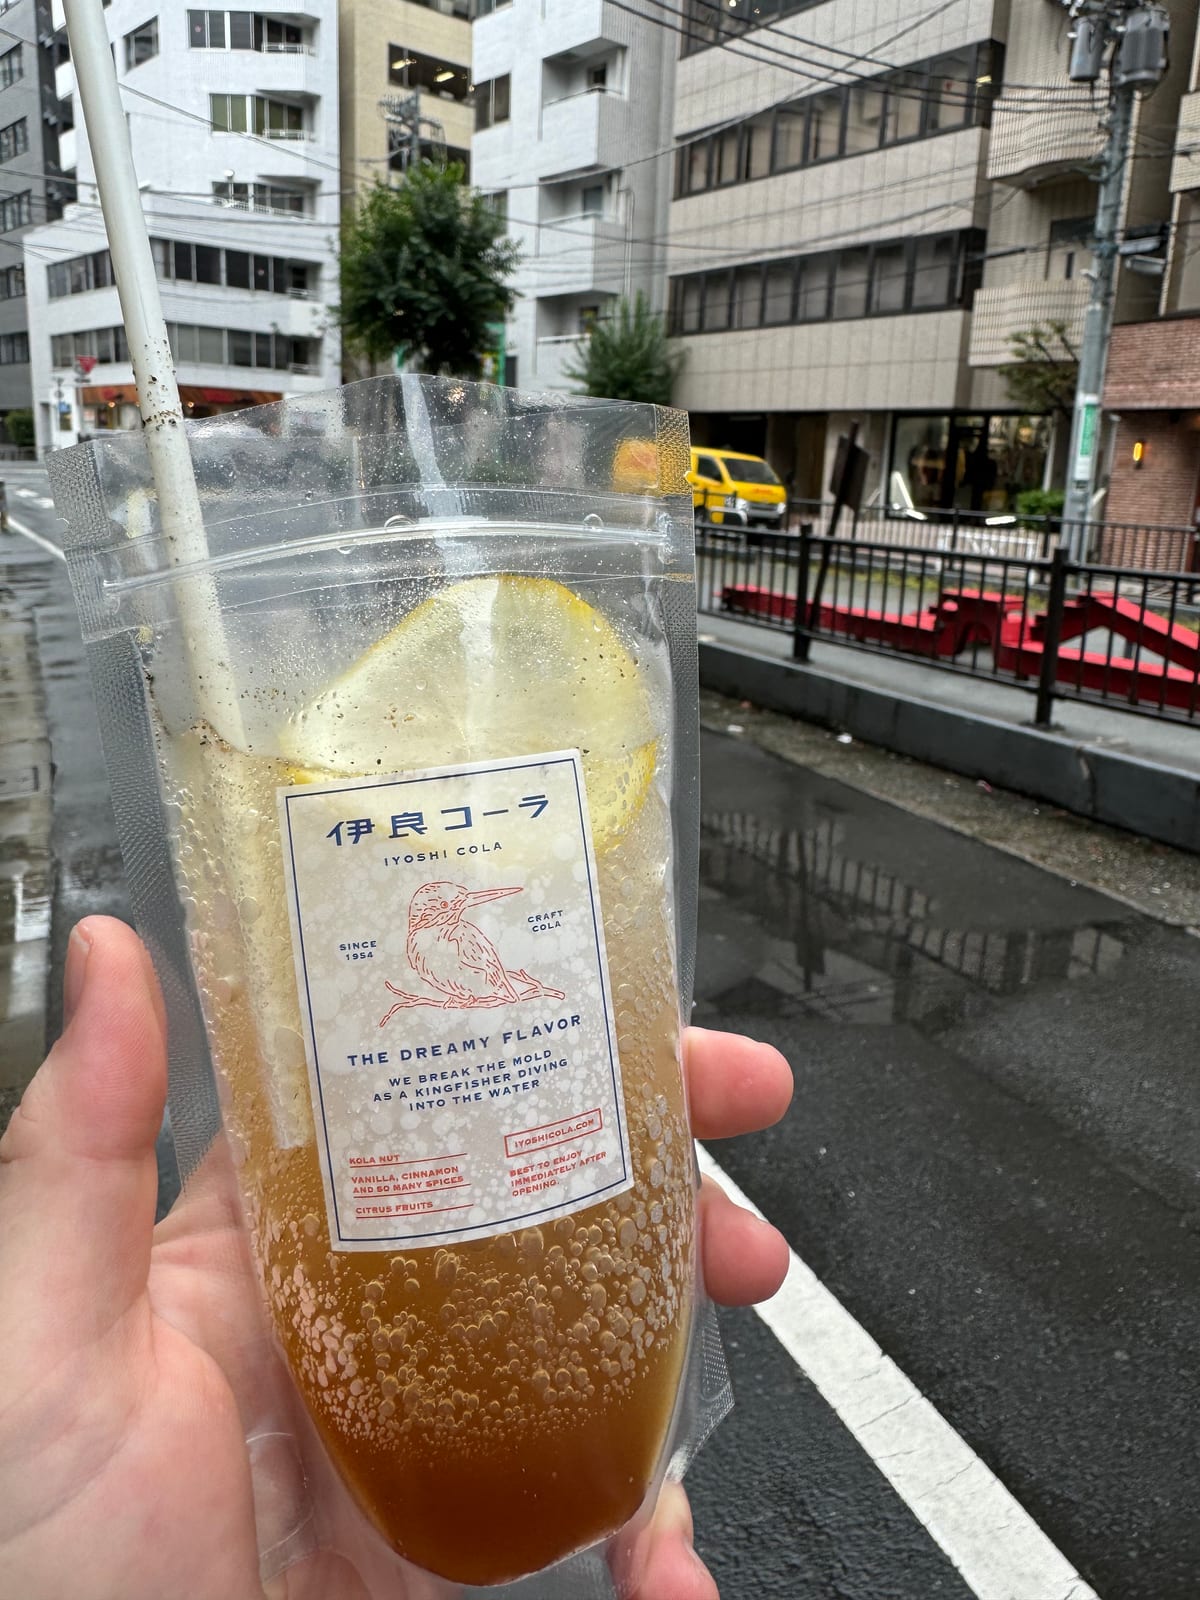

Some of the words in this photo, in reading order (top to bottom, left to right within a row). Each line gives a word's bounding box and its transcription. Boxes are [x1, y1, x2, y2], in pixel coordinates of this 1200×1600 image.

[326, 794, 549, 846] 伊良コーラ
[384, 850, 448, 866] IYOSHI
[456, 841, 503, 856] COLA
[527, 909, 564, 923] CRAFT
[532, 921, 561, 932] COLA
[339, 940, 378, 951] SINCE
[345, 951, 374, 961] 1954
[347, 1051, 389, 1066] THE
[400, 1036, 490, 1061] DREAMY
[502, 1014, 581, 1044] FLAVOR
[388, 1076, 411, 1087] WE
[418, 1067, 471, 1083] BREAK
[476, 1060, 506, 1073] THE
[513, 1050, 552, 1066] MOLD
[373, 1092, 392, 1102] AS
[399, 1091, 408, 1099] A
[415, 1073, 511, 1097] KINGFISHER
[518, 1058, 568, 1078] DIVING
[409, 1099, 446, 1111] INTO
[452, 1092, 482, 1104] THE
[489, 1079, 540, 1098] WATER
[515, 1118, 594, 1148] IYOSHICOLA.COM
[349, 1156, 376, 1165] KOLA
[379, 1154, 400, 1163] NUT
[509, 1164, 535, 1177] BEST
[537, 1160, 550, 1169] TO
[553, 1150, 582, 1165] ENJOY
[511, 1162, 577, 1187] IMMEDIATELY
[579, 1151, 607, 1167] AFTER
[351, 1174, 399, 1184] VANILLA,
[401, 1166, 458, 1180] CINNAMON
[353, 1185, 374, 1194] AND
[376, 1184, 389, 1192] SO
[393, 1182, 422, 1191] MANY
[426, 1175, 464, 1187] SPICES
[512, 1179, 560, 1197] OPENING.
[356, 1205, 392, 1214] CITRUS
[395, 1201, 434, 1212] FRUITS
